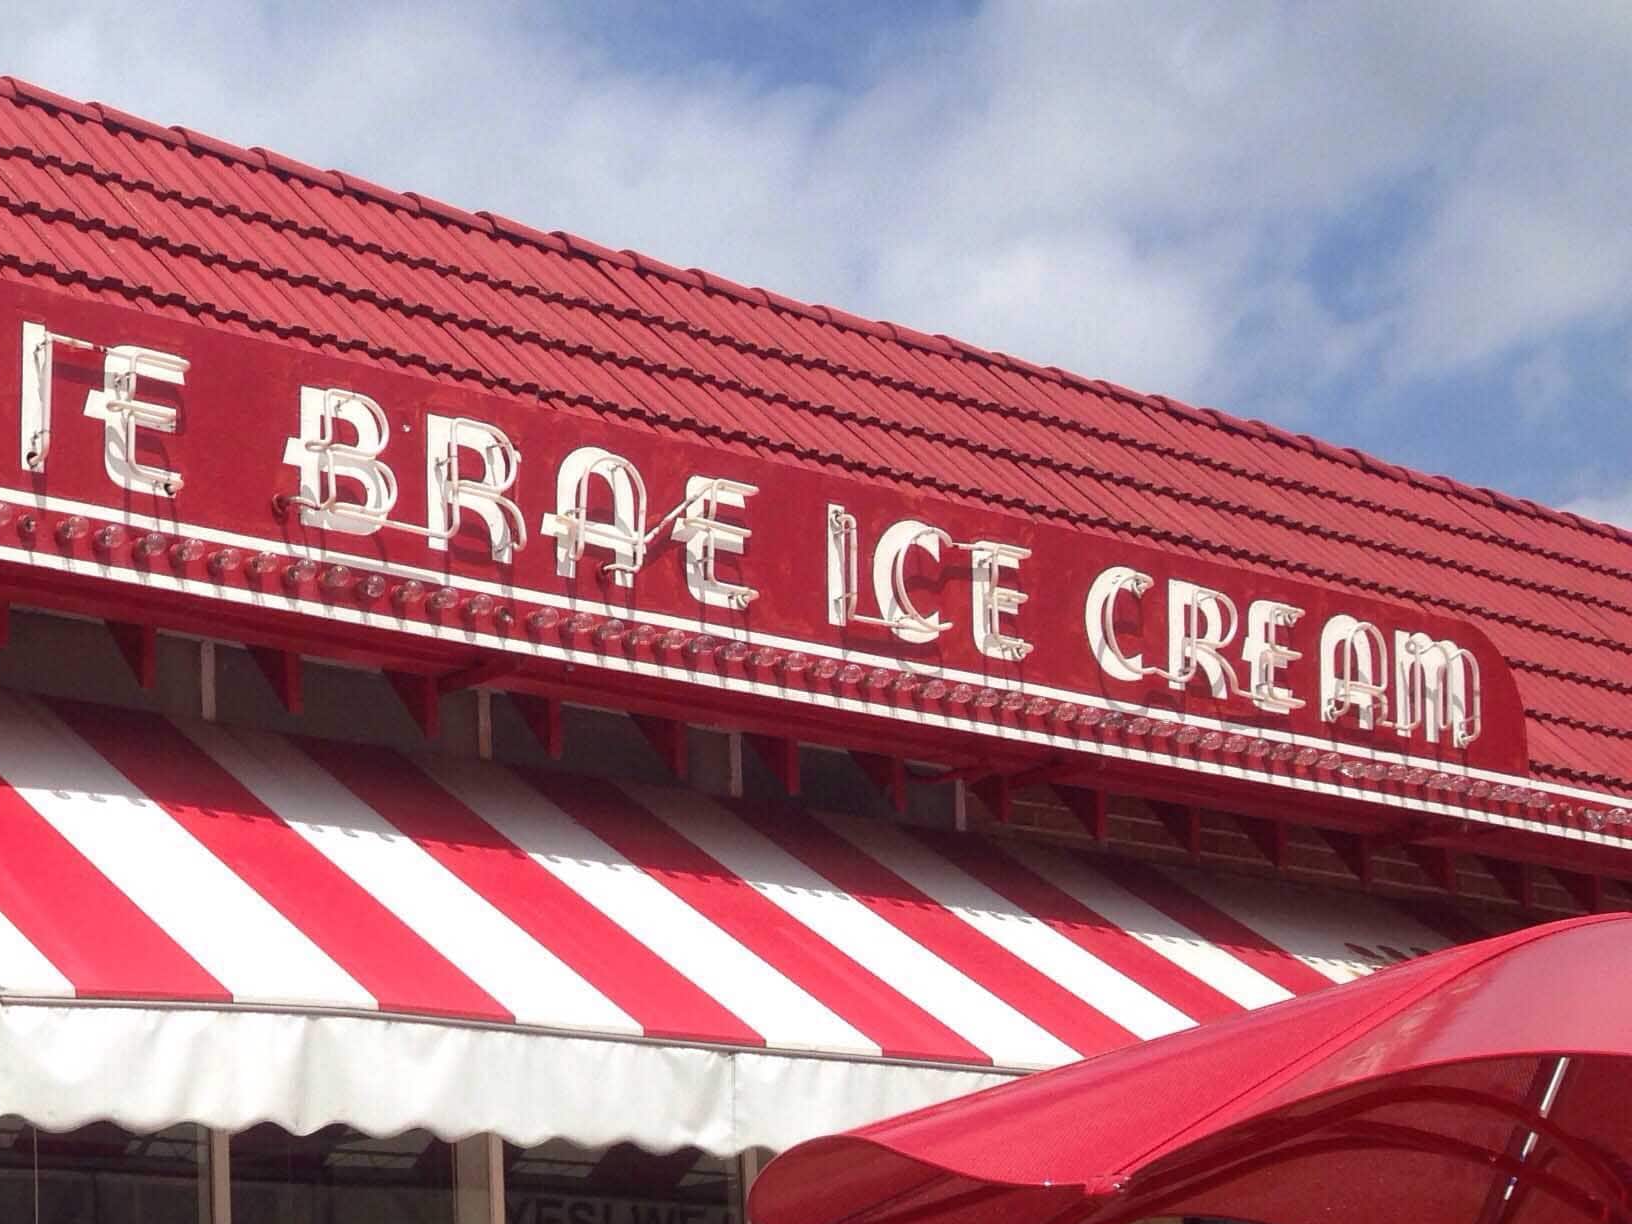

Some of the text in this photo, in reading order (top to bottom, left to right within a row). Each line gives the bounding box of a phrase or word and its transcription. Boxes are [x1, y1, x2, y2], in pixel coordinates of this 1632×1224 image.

[276, 384, 760, 611] BRAE
[827, 503, 1035, 661] ICE
[1085, 565, 1482, 750] CREAM
